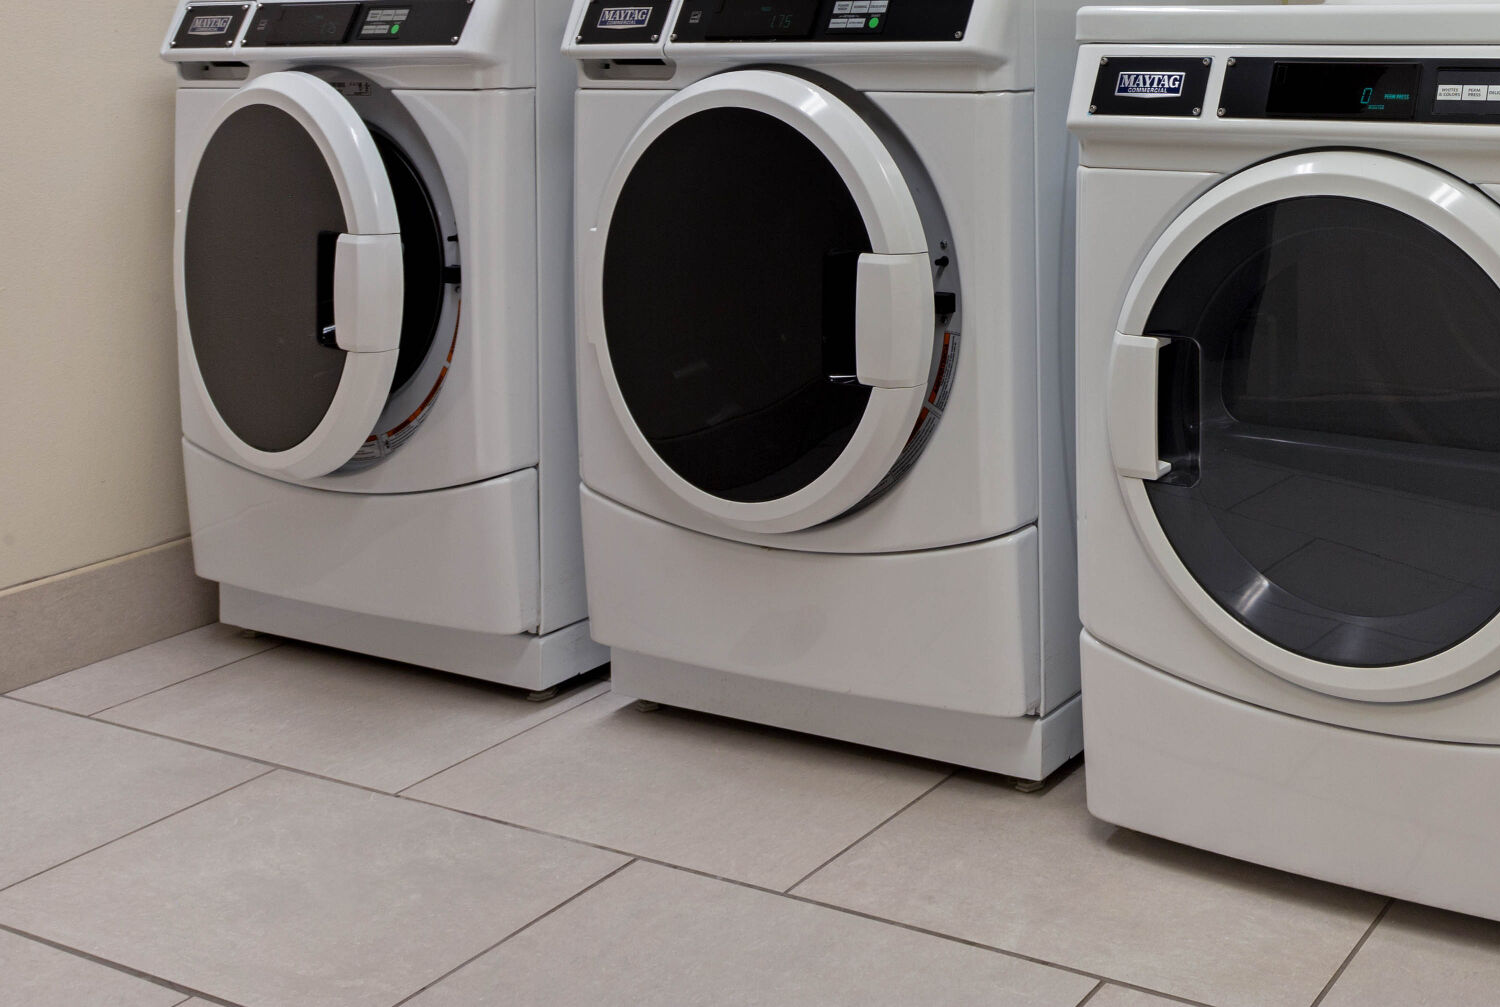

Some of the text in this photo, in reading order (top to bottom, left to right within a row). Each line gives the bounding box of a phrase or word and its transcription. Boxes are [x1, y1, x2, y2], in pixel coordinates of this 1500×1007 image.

[602, 9, 648, 21] MAYTAG
[1120, 74, 1180, 88] MAYTAG
[1360, 87, 1373, 104] 0
